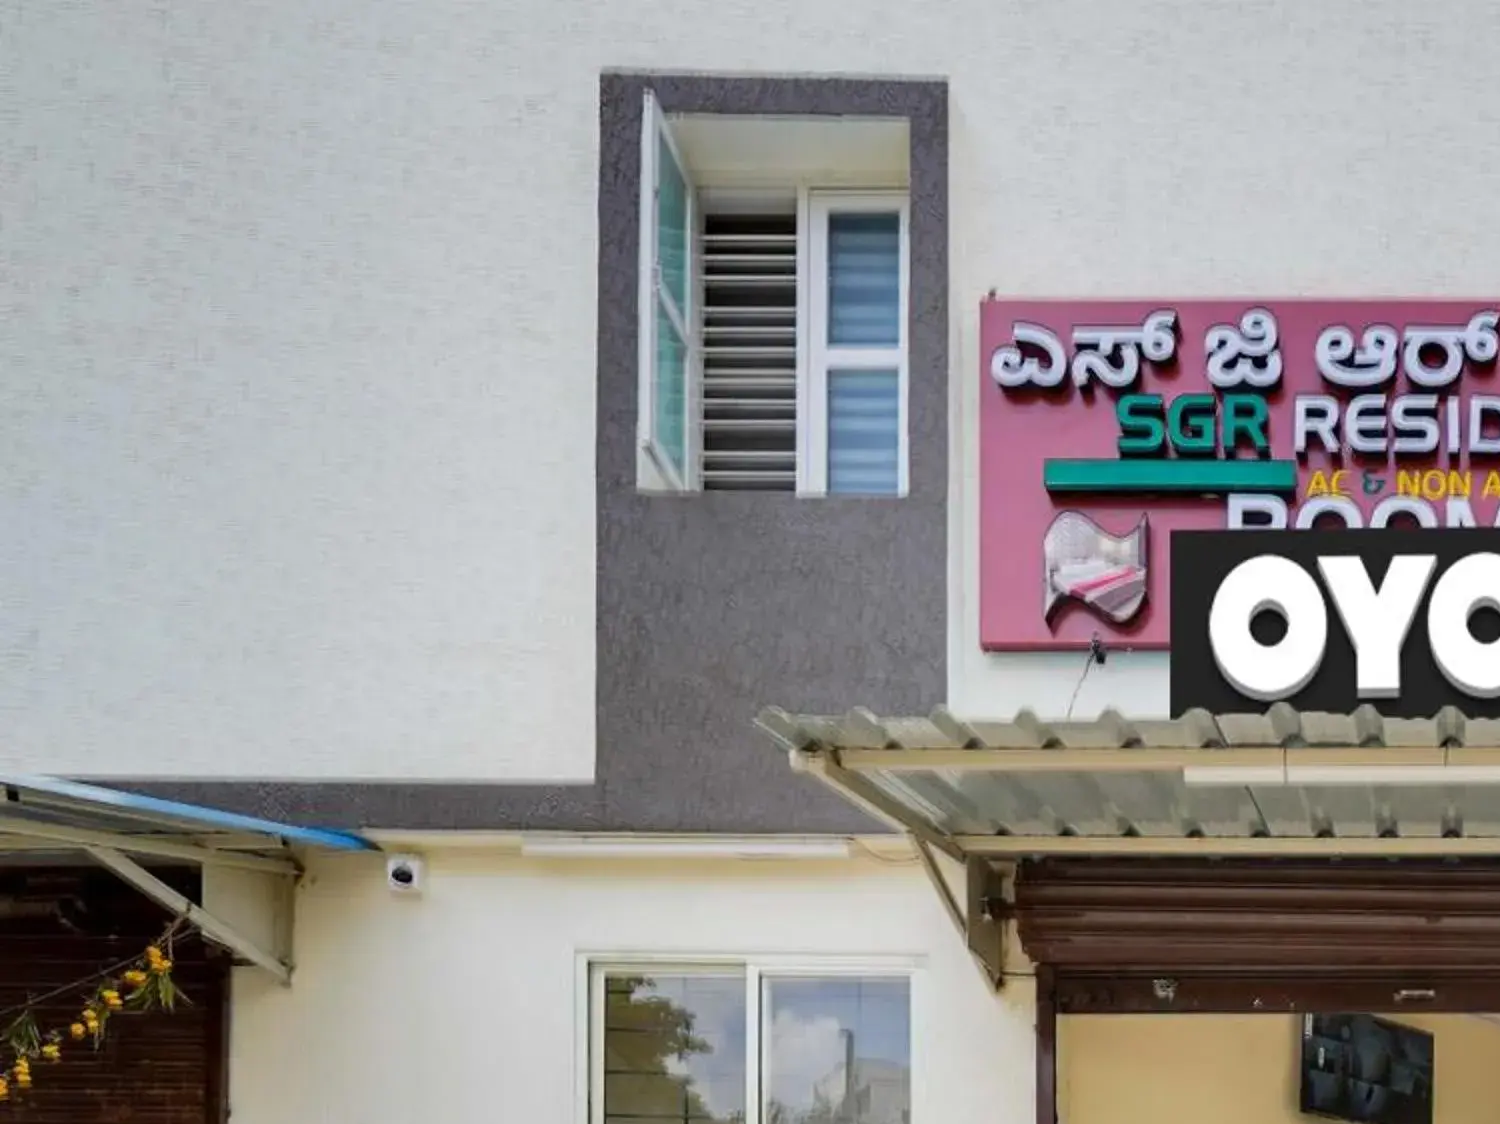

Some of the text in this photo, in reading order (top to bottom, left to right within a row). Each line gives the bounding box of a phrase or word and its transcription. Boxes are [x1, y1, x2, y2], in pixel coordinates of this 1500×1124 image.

[990, 308, 1177, 388] ಎಸ್
[1204, 307, 1284, 388] ಜಿ
[1115, 393, 1271, 455] SGR
[1306, 470, 1352, 497] AC
[1361, 471, 1386, 495] &
[1396, 471, 1472, 499] NON
